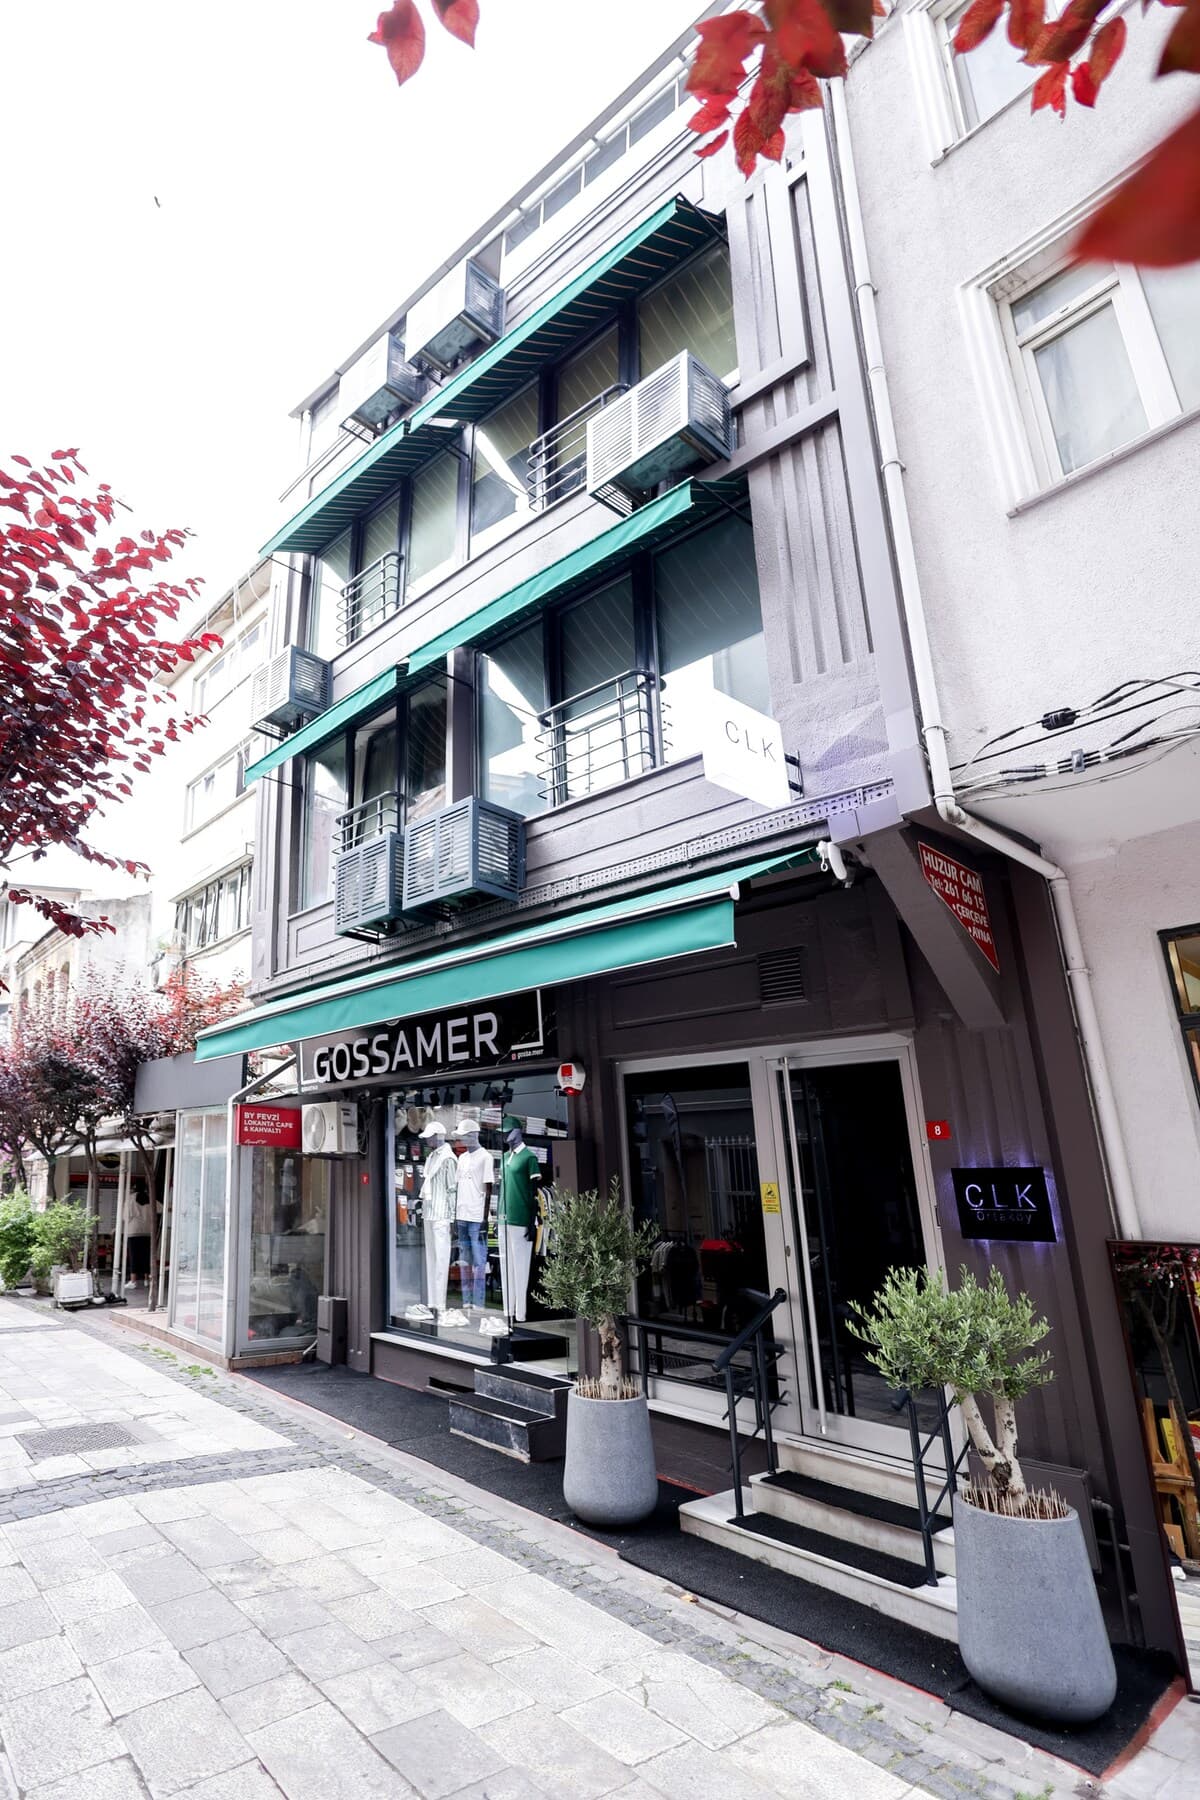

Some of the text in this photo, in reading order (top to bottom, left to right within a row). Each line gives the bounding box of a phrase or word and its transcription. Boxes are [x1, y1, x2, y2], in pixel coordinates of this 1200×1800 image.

[725, 720, 777, 763] CLK
[923, 850, 981, 893] HUZUR CAM
[974, 895, 985, 911] 15
[972, 927, 991, 944] AYNA
[313, 1011, 500, 1084] GOSSAMER
[934, 1125, 942, 1136] 8
[964, 1183, 1037, 1209] CLK
